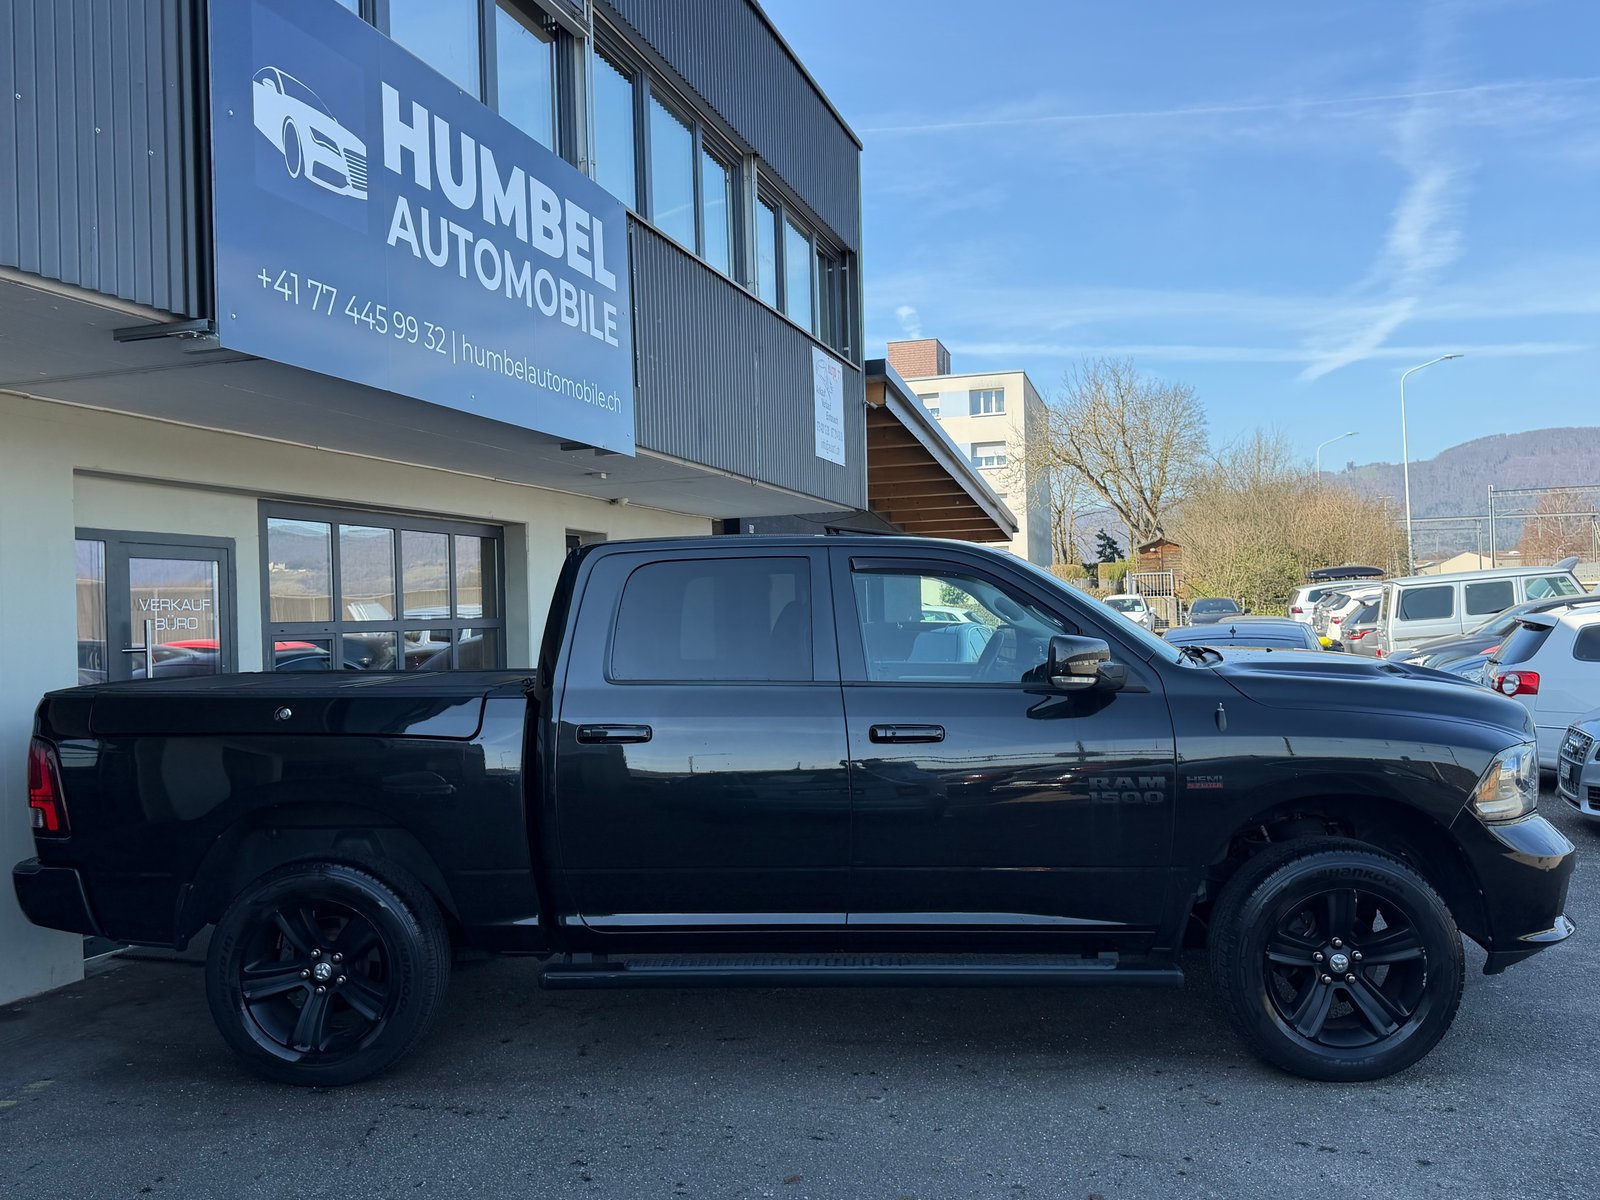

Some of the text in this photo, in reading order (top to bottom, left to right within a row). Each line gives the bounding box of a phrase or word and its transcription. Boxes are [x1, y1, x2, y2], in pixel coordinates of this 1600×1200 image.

[381, 81, 617, 292] HUMBEL
[387, 195, 619, 348] AUTOMOBILE
[257, 268, 298, 305] +41
[306, 279, 338, 316] 77
[345, 295, 388, 334] 445
[393, 311, 419, 344] 99
[423, 321, 447, 354] 32
[462, 335, 622, 415] humbelautomobile.ch
[139, 598, 211, 611] VERKAUF
[155, 614, 199, 631] BÜRO
[1088, 776, 1166, 789] RAM
[1186, 775, 1223, 783] HEMI
[1088, 790, 1164, 804] 1500
